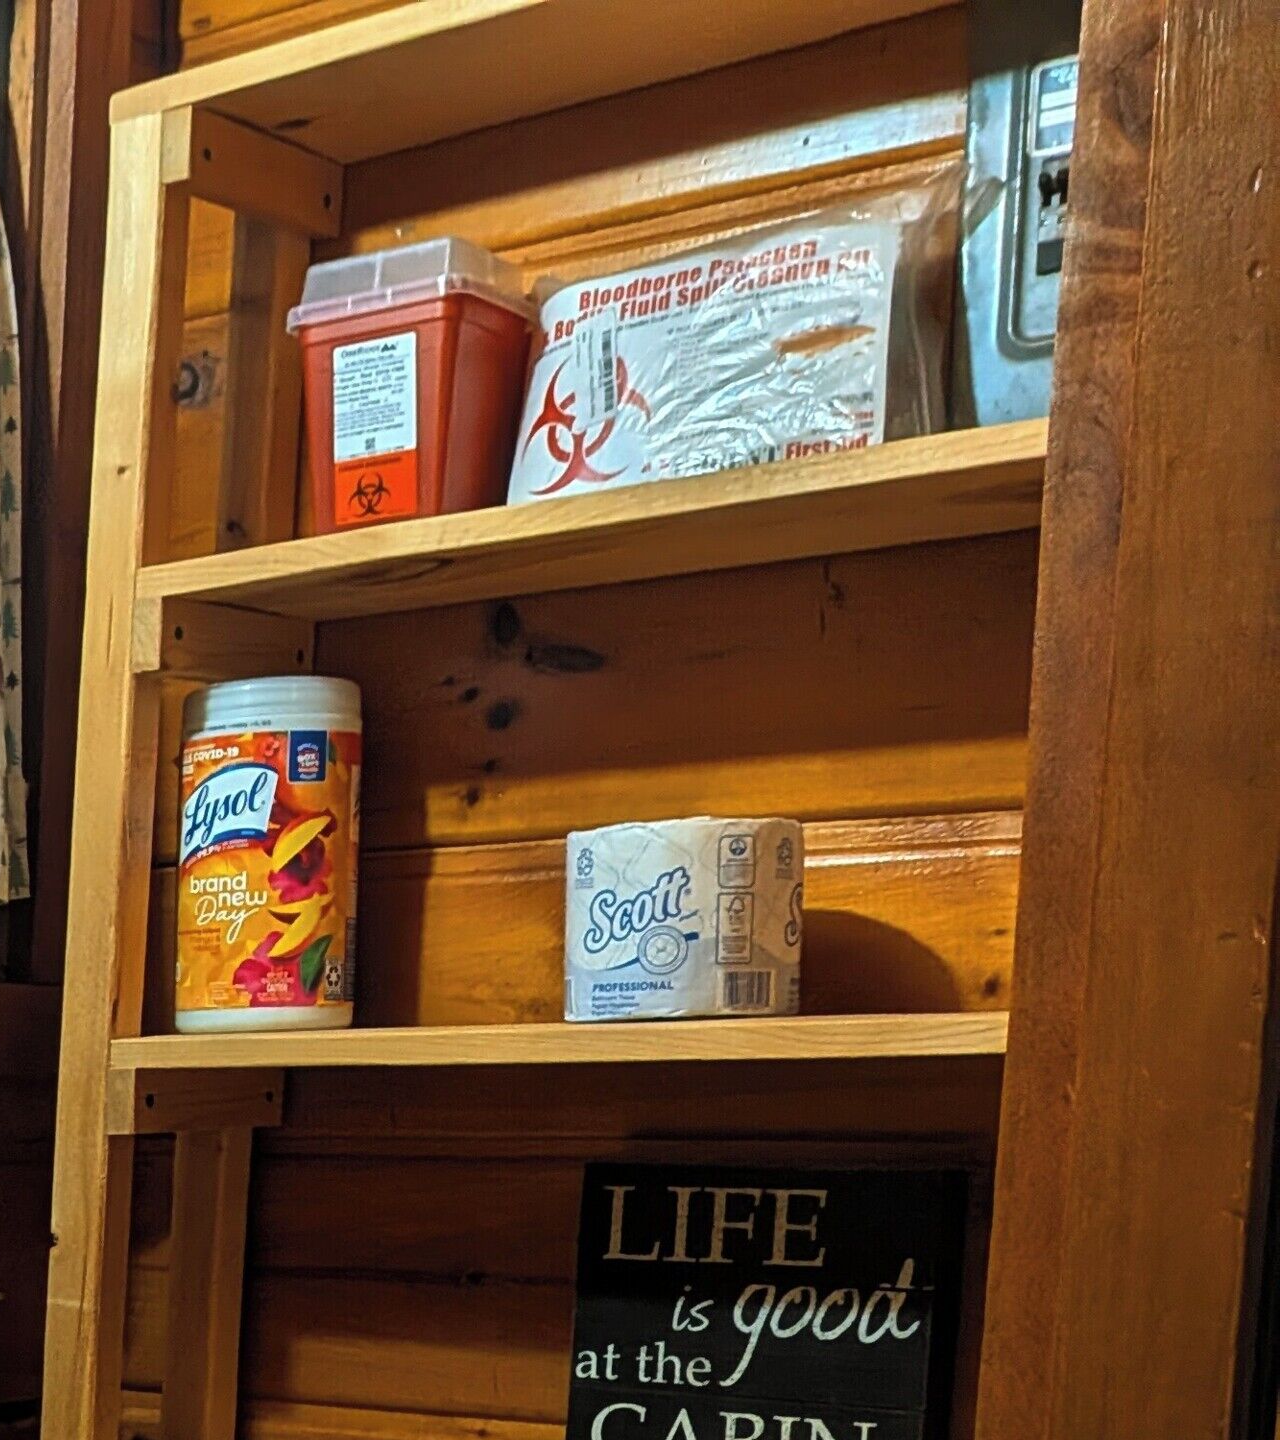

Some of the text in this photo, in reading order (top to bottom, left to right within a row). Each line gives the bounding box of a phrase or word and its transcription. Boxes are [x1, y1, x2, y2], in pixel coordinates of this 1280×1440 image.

[579, 266, 702, 312] Bloodborne
[620, 292, 673, 321] Fluid
[785, 439, 832, 460] First
[184, 772, 268, 846] Lysol
[190, 871, 247, 894] brand
[218, 890, 268, 907] new
[195, 895, 260, 944] Day
[584, 866, 691, 953] Scott
[592, 981, 674, 992] PROFESSIONAL
[602, 1185, 828, 1267] LIFE
[671, 1257, 935, 1387] is good
[575, 1341, 712, 1387] at the
